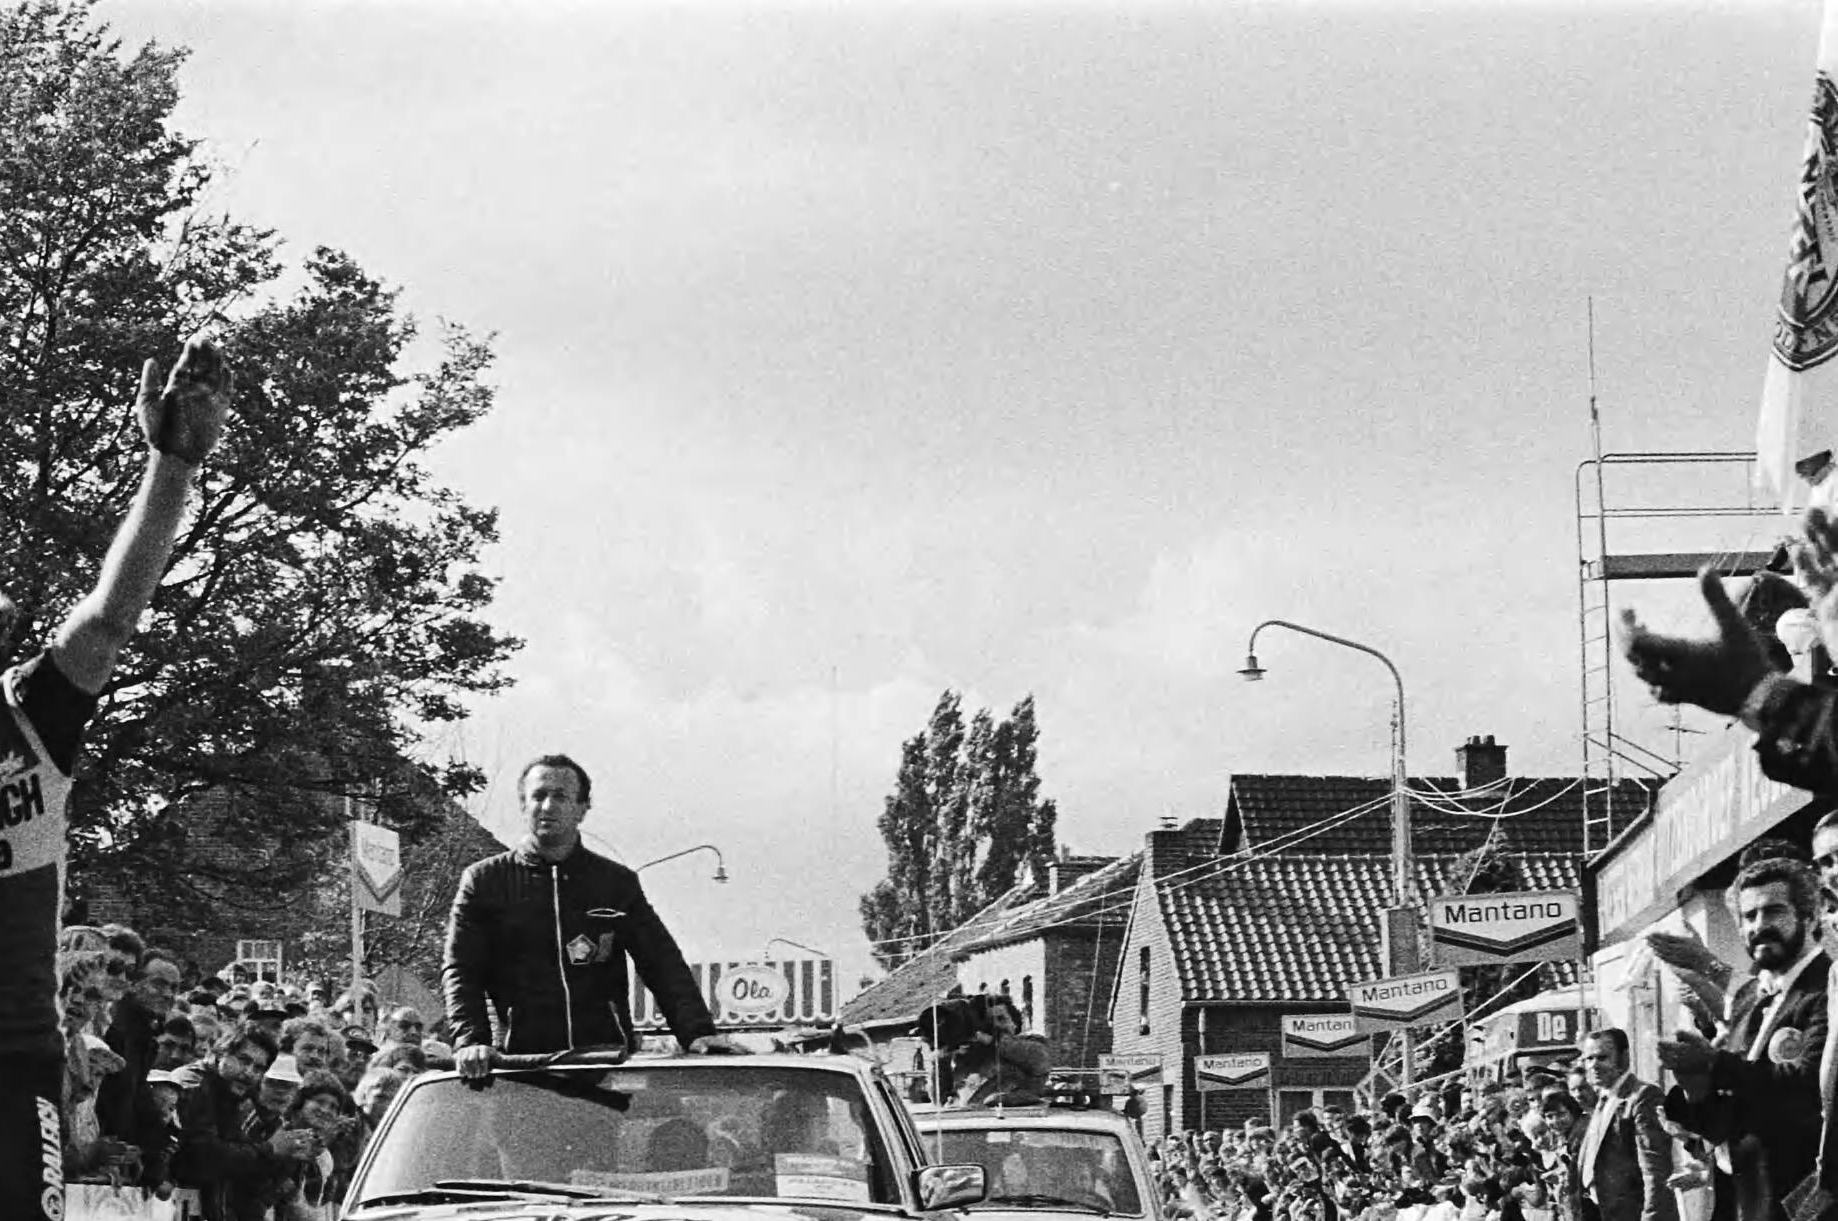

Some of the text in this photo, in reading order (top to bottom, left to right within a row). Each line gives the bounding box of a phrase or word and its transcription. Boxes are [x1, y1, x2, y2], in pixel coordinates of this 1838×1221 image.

[1445, 902, 1562, 924] Mantano
[733, 977, 771, 1001] Ola
[1362, 976, 1448, 1003] Mantano
[1292, 1018, 1356, 1033] Mantan
[1537, 1011, 1567, 1042] De
